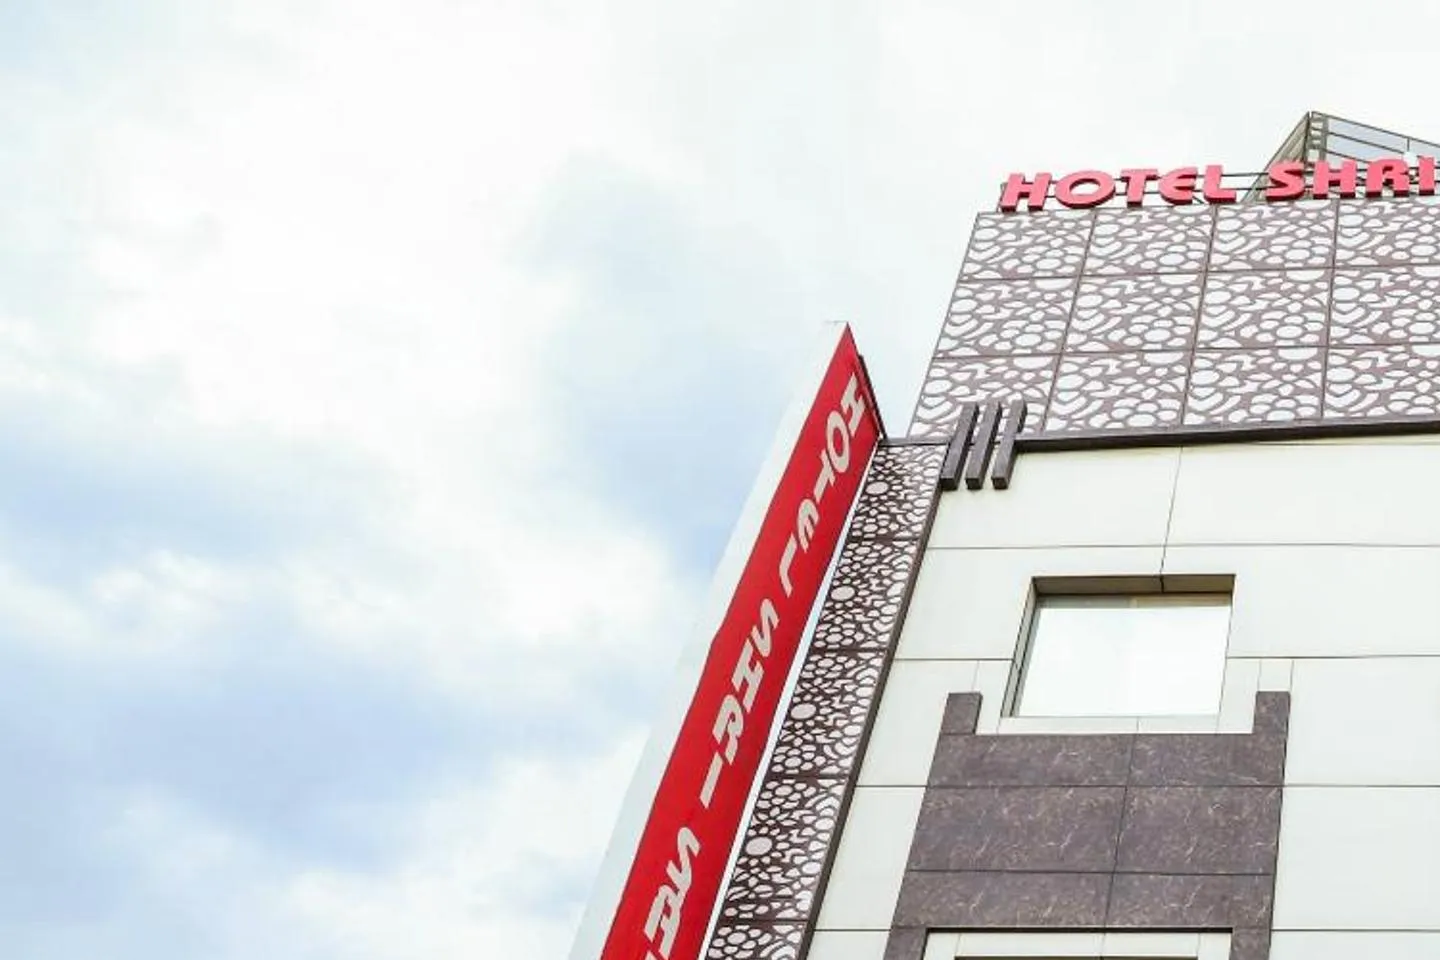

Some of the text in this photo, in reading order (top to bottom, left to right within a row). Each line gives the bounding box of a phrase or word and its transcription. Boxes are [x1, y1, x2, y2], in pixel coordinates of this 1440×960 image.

[1001, 164, 1236, 213] HOTEL
[1265, 155, 1435, 200] SHRI
[779, 371, 866, 597] HOTEL
